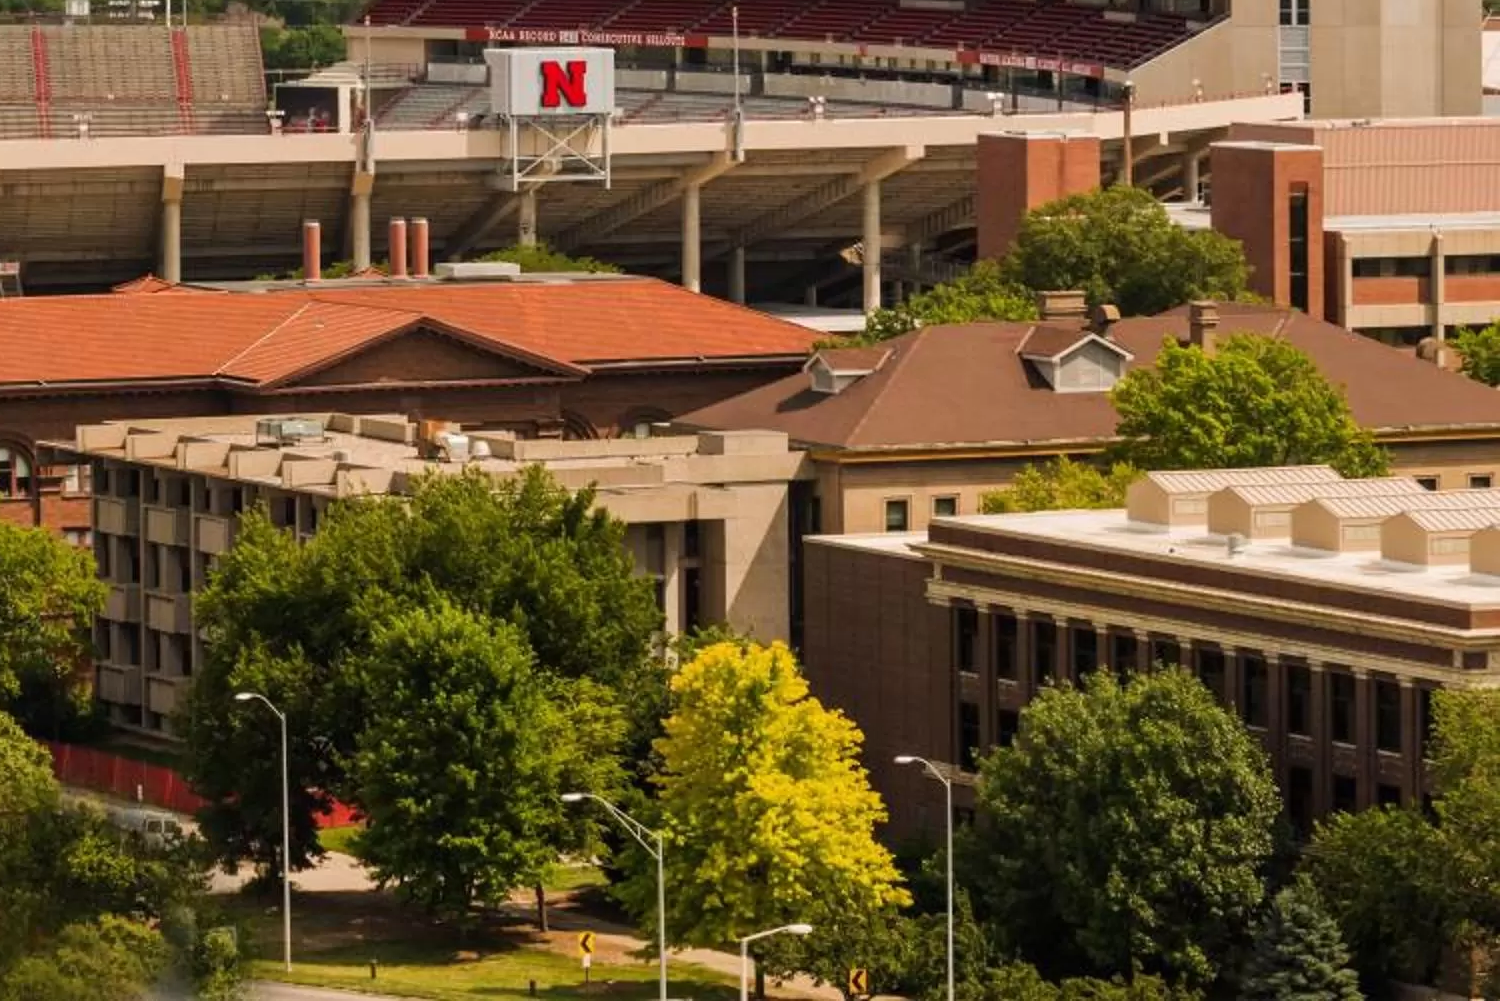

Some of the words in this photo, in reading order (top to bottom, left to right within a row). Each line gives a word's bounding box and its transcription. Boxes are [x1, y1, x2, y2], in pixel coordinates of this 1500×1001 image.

[489, 30, 515, 40] NCAA
[519, 30, 557, 41] RECORD
[581, 31, 643, 44] CONSECUTIVE
[540, 61, 587, 107] N
